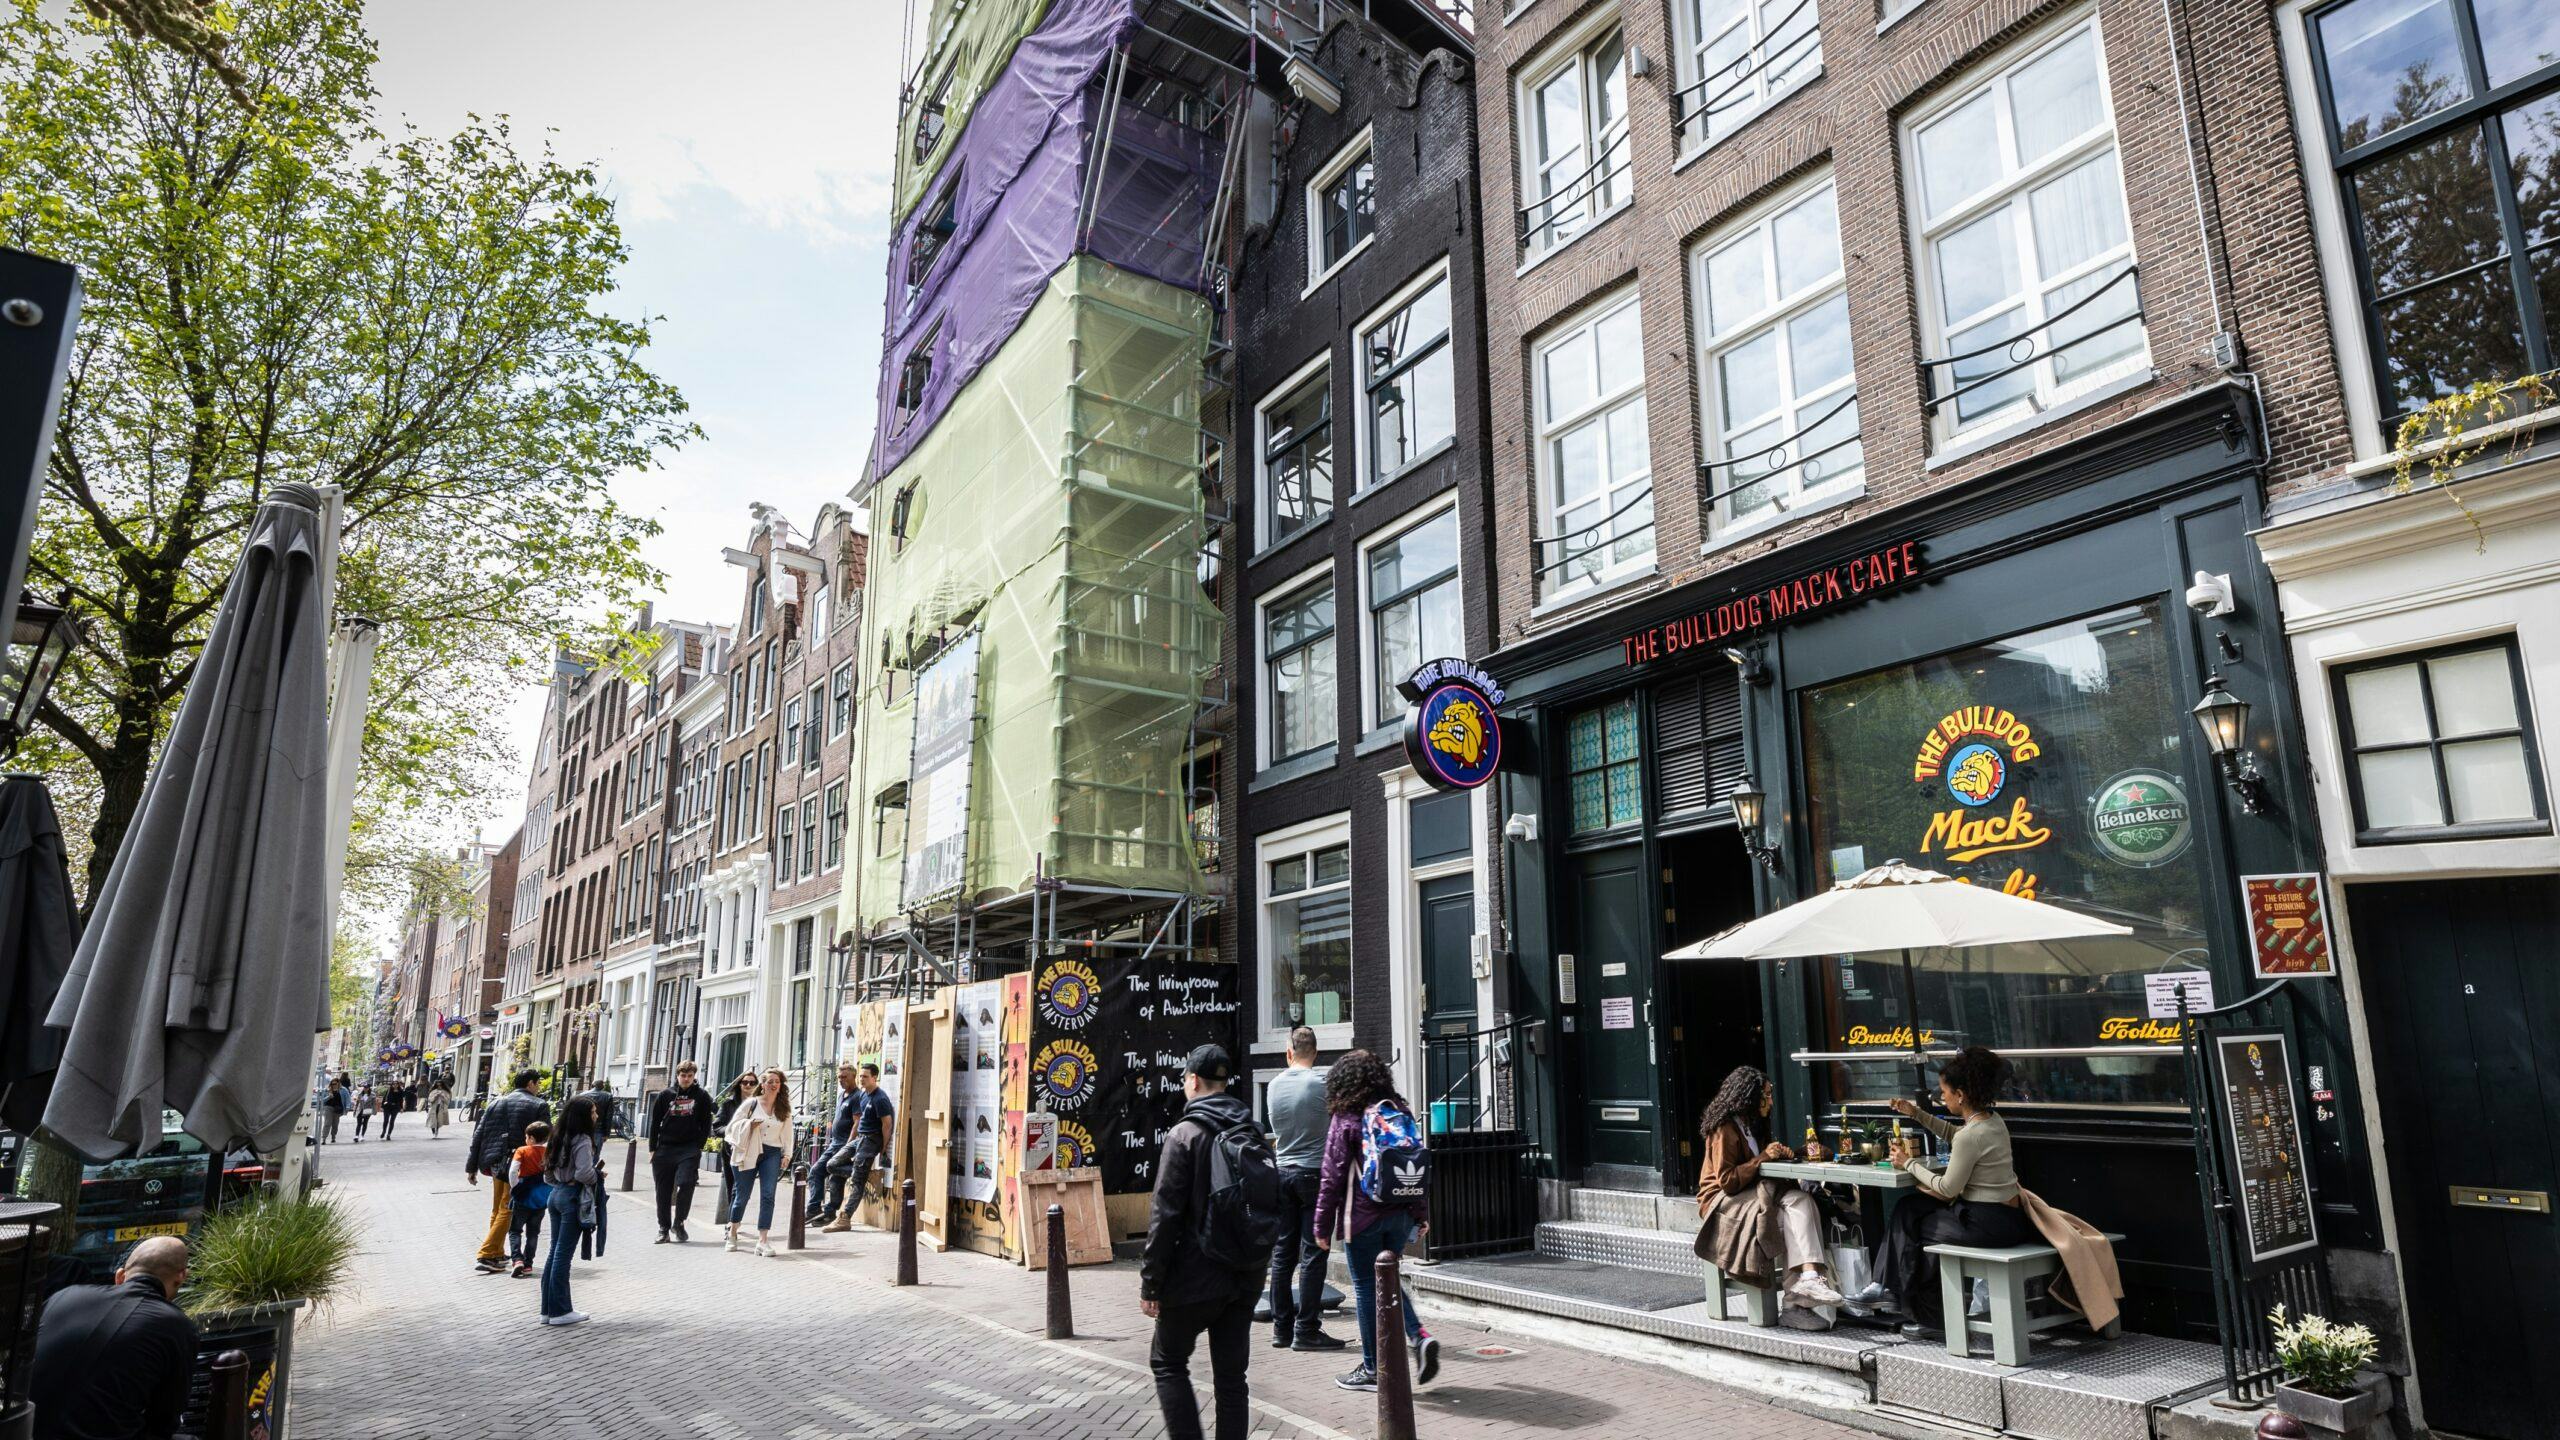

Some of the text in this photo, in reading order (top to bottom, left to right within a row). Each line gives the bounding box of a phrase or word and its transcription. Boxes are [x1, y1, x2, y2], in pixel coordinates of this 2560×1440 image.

[1622, 541, 1918, 666] THE BULLDOG MACK CAFE
[1412, 660, 1505, 705] THE BULLDOG
[1915, 706, 2041, 782] THE BULLDOG
[1920, 796, 2052, 862] Mack
[2098, 807, 2184, 830] Heineken
[2264, 893, 2303, 902] THE FUTURE
[2264, 902, 2306, 911] OF DRINKING
[1038, 960, 1101, 994] THE BULLDOG
[1127, 974, 1219, 1001] The livingroom
[2465, 984, 2476, 994] a
[1039, 1003, 1099, 1030] AMSTERDAM
[1139, 1004, 1155, 1020] of
[1033, 1039, 1099, 1074] THE BULLDOG
[1123, 1051, 1147, 1068] The
[1034, 1083, 1095, 1111] AMSTERDAM
[1136, 1082, 1151, 1098] of
[1121, 1131, 1145, 1148] The
[1134, 1161, 1149, 1177] of
[1392, 1187, 1424, 1196] adidas
